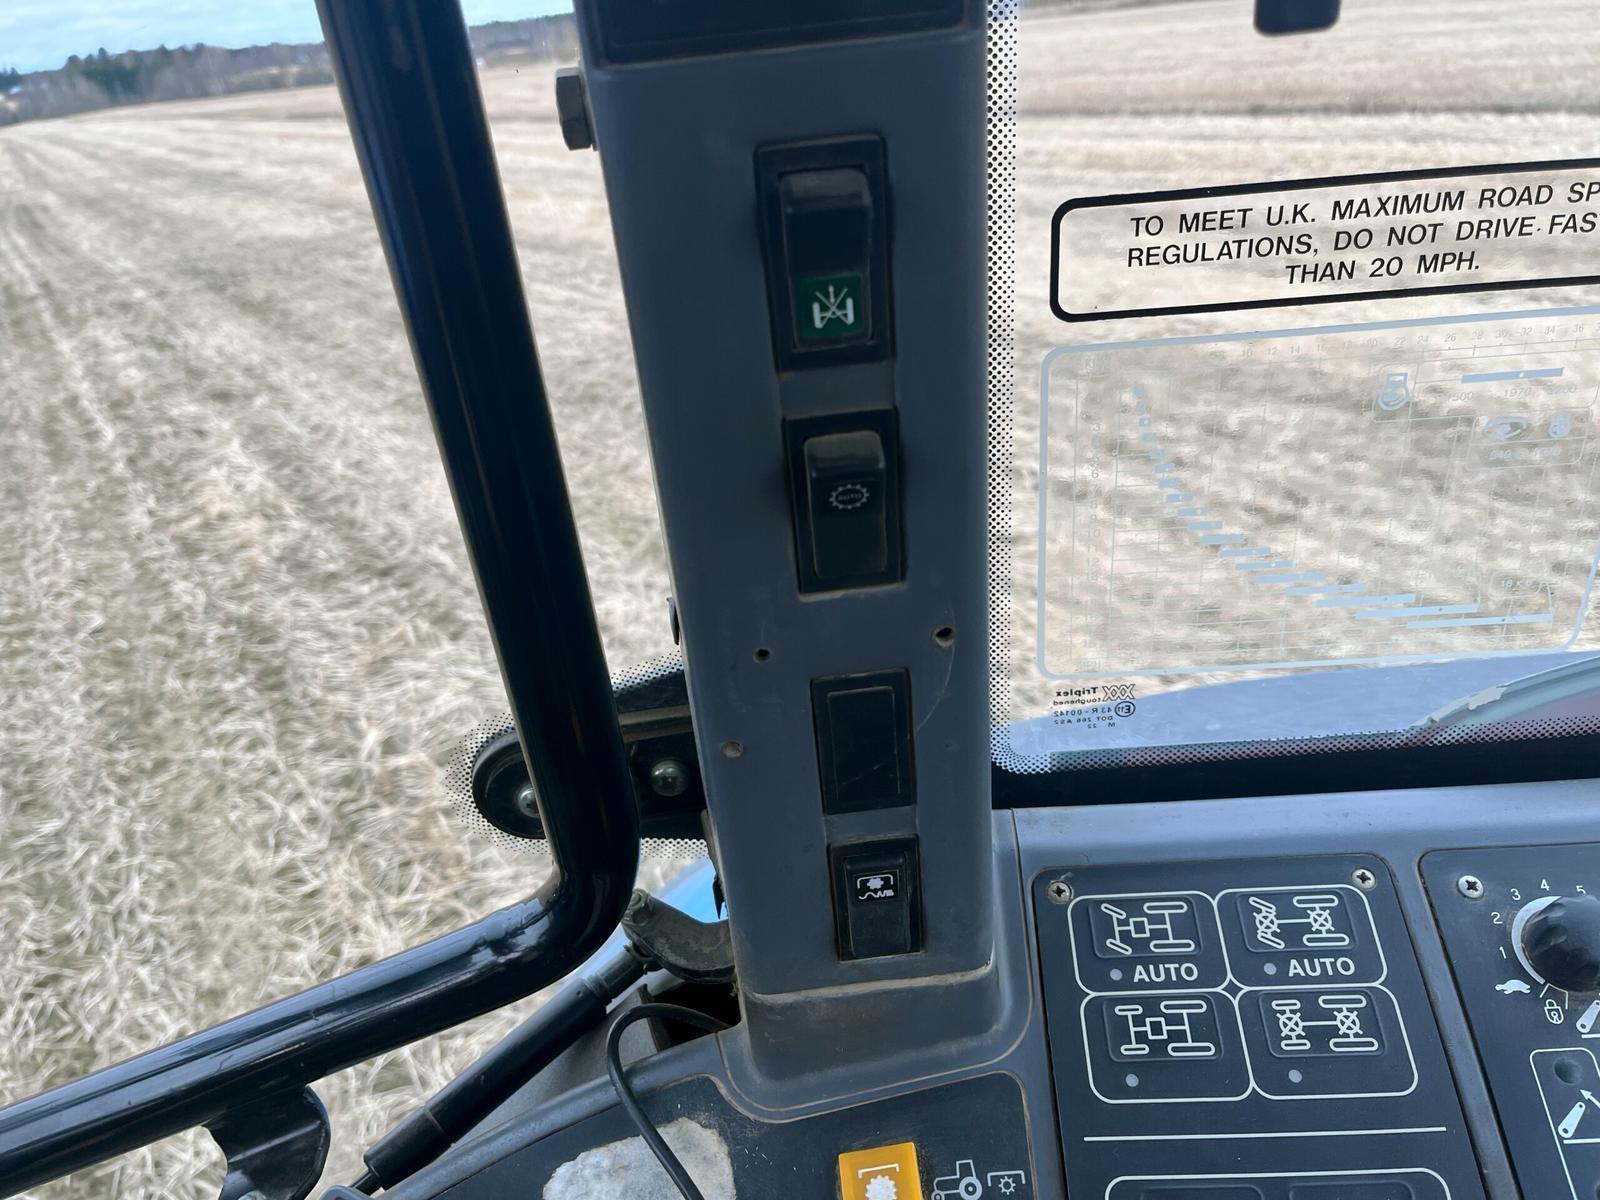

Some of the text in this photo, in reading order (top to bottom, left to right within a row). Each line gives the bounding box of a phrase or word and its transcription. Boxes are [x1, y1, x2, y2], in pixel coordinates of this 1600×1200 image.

[1130, 215, 1164, 238] TO
[1178, 207, 1254, 234] MEET
[1266, 203, 1316, 227] U.K.
[1331, 190, 1466, 221] MAXIMUM
[1478, 184, 1553, 209] ROAD
[1127, 211, 1600, 268] REGULATIONS, DO NOT DRIVE FAS
[1285, 250, 1480, 285] THAN 20 MPH.
[1503, 387, 1532, 397] 1970
[1540, 879, 1550, 892] 4
[1510, 888, 1521, 901] 3
[1490, 911, 1504, 925] 2
[1499, 946, 1507, 959] 1
[1133, 962, 1199, 983] AUTO
[1288, 957, 1355, 977] AUTO
